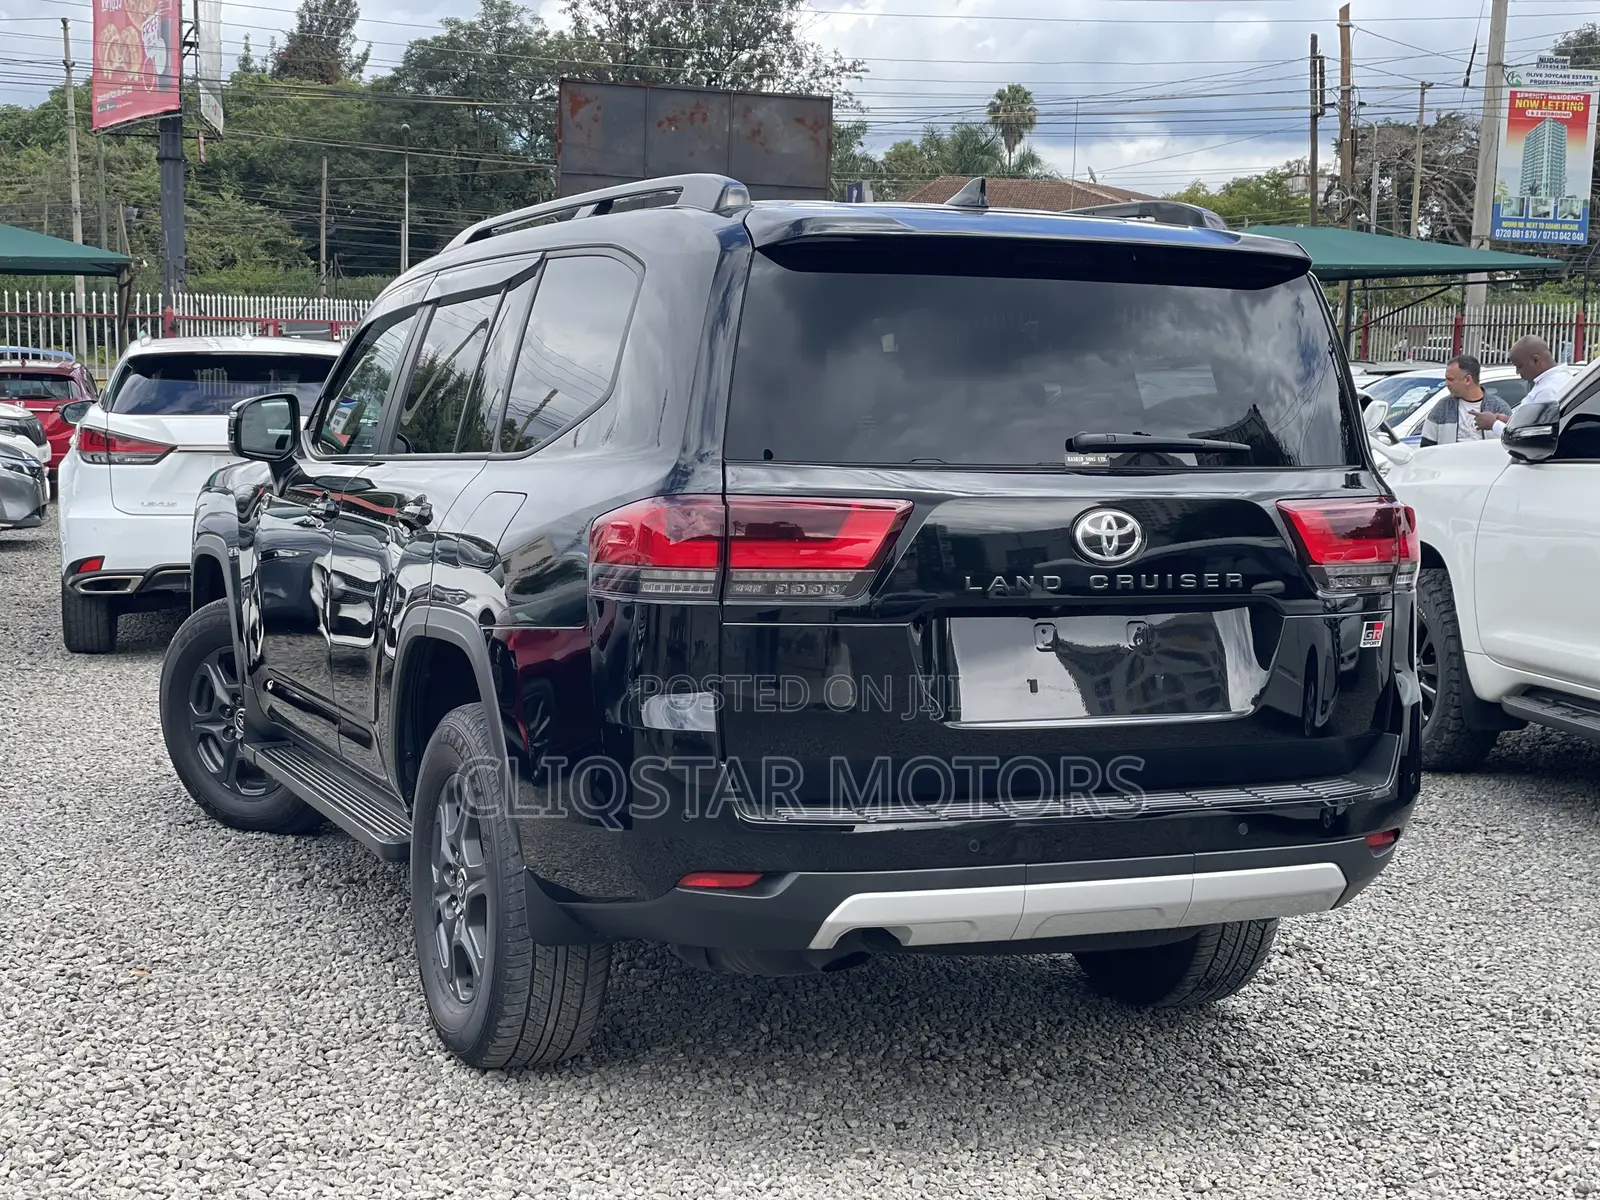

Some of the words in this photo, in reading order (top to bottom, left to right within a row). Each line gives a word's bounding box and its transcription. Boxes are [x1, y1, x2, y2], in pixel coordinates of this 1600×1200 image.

[1548, 93, 1585, 101] RESIDENCY
[1515, 99, 1540, 109] NOW
[1542, 101, 1584, 111] LETTING
[1495, 228, 1511, 238] 0720
[1525, 229, 1537, 239] 870
[1543, 230, 1558, 240] 0713
[965, 575, 1062, 592] LAND
[1089, 573, 1243, 590] CRUISER
[1364, 629, 1381, 640] GR
